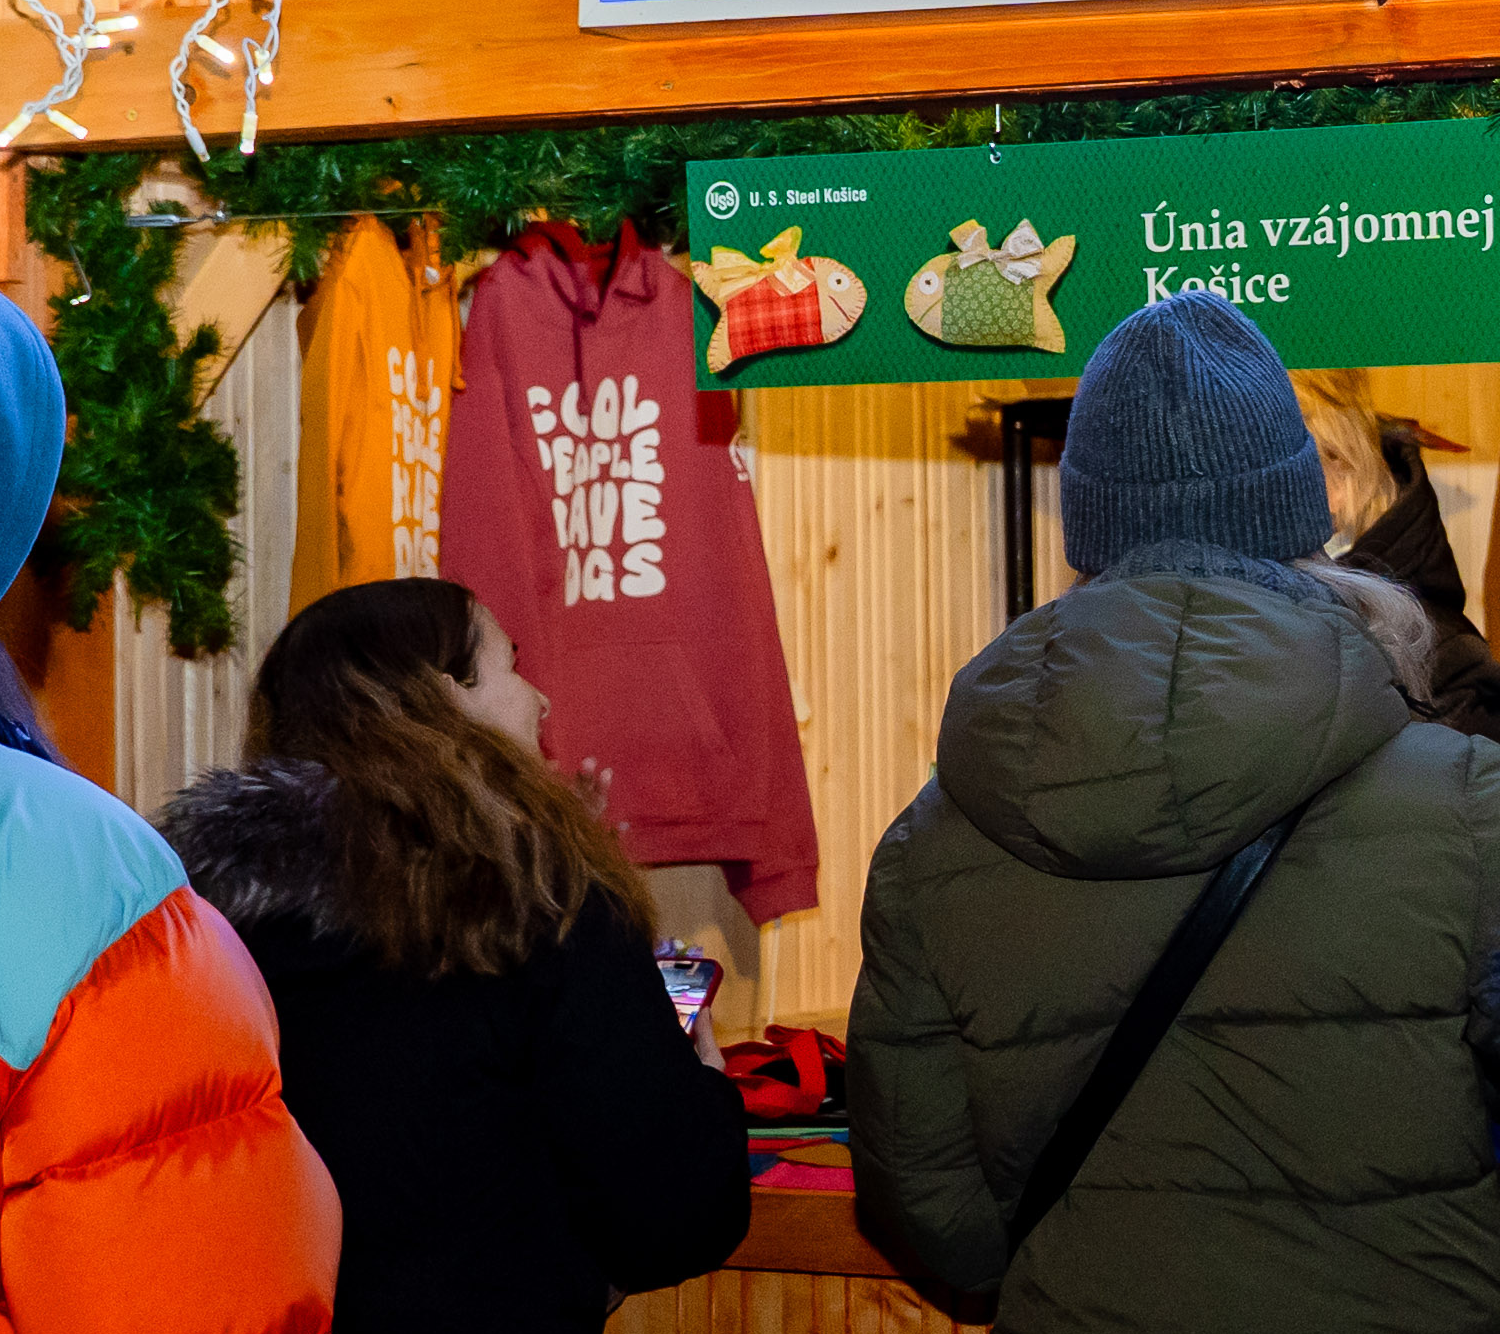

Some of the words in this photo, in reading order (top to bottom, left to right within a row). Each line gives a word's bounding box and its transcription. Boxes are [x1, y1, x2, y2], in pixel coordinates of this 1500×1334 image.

[786, 188, 820, 206] Steel
[823, 186, 867, 203] Košice
[1141, 200, 1248, 252] Únia
[1259, 193, 1494, 258] vzájomnej
[1143, 263, 1290, 308] Košice
